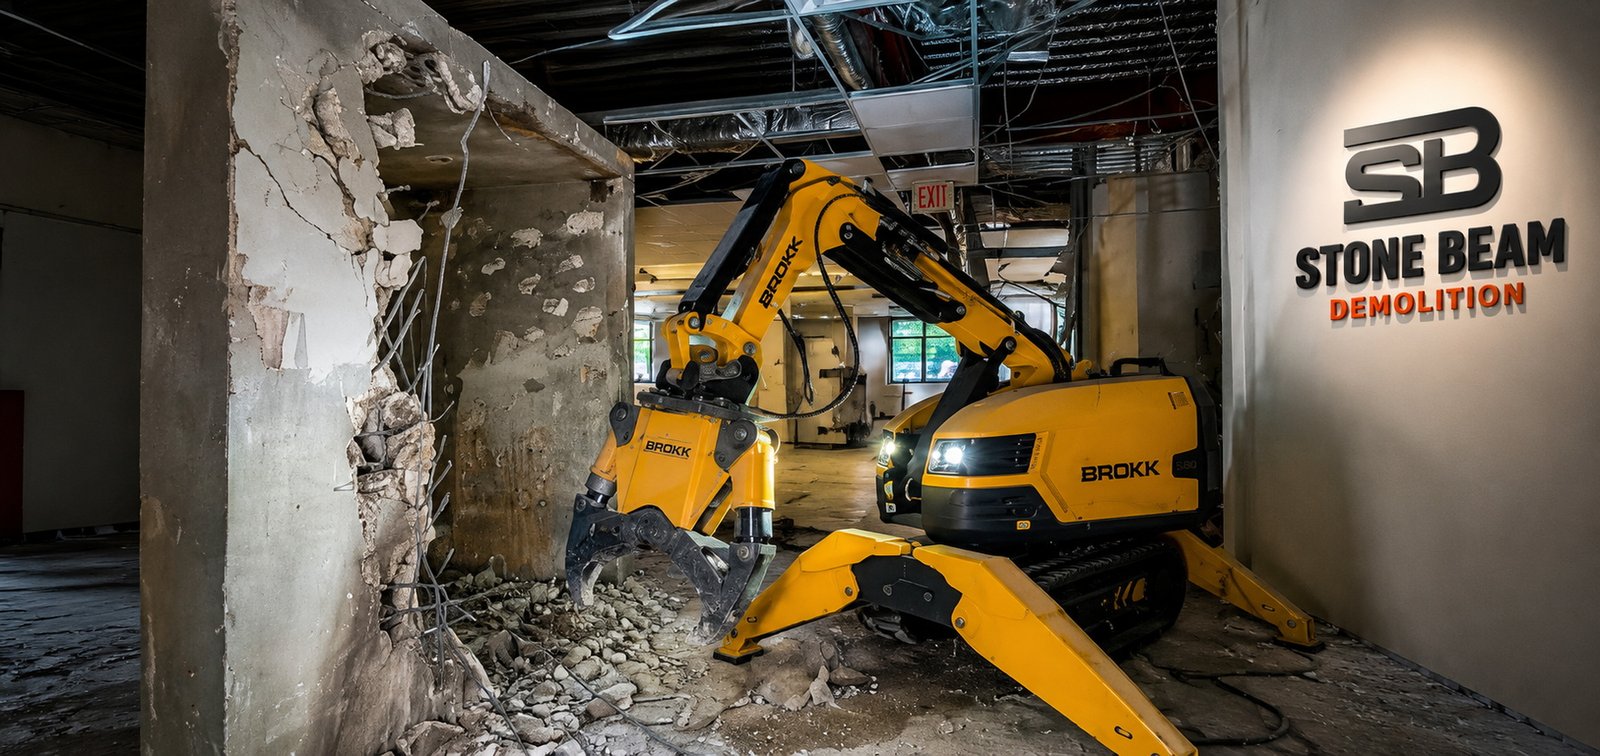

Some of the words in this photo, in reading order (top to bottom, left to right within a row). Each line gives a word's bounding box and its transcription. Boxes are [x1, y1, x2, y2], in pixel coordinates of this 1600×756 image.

[918, 184, 948, 209] EXIT
[1295, 234, 1424, 290] STONE
[1438, 217, 1565, 275] BEAM
[759, 235, 803, 309] BROKK
[1329, 281, 1524, 321] DEMOLITION
[645, 440, 692, 458] BROKK
[1081, 459, 1160, 482] BROKK
